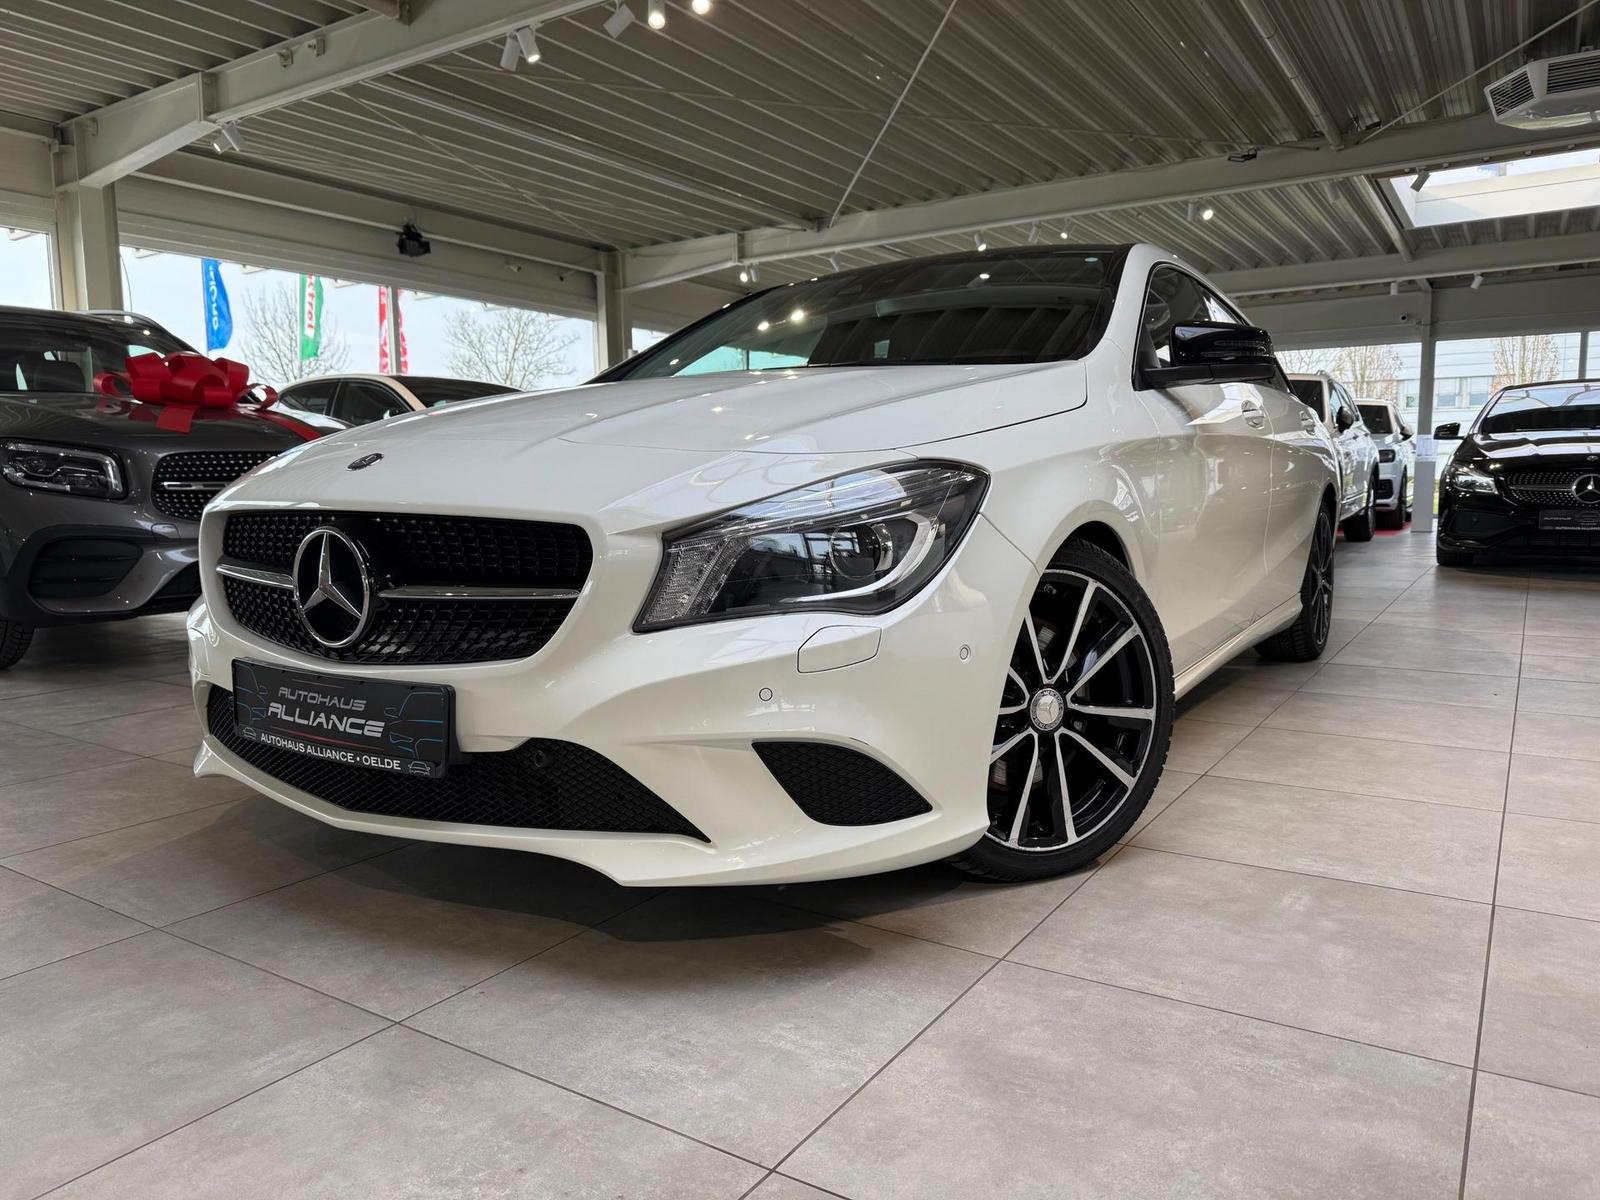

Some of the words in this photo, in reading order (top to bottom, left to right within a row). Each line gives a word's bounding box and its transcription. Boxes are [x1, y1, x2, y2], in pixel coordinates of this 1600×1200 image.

[278, 686, 366, 711] AUTOHAUS
[268, 702, 385, 738] ALLIANCE
[260, 733, 305, 753] AUTOHAUS
[306, 742, 355, 763] ALLIANCE
[362, 755, 401, 770] OELDE
